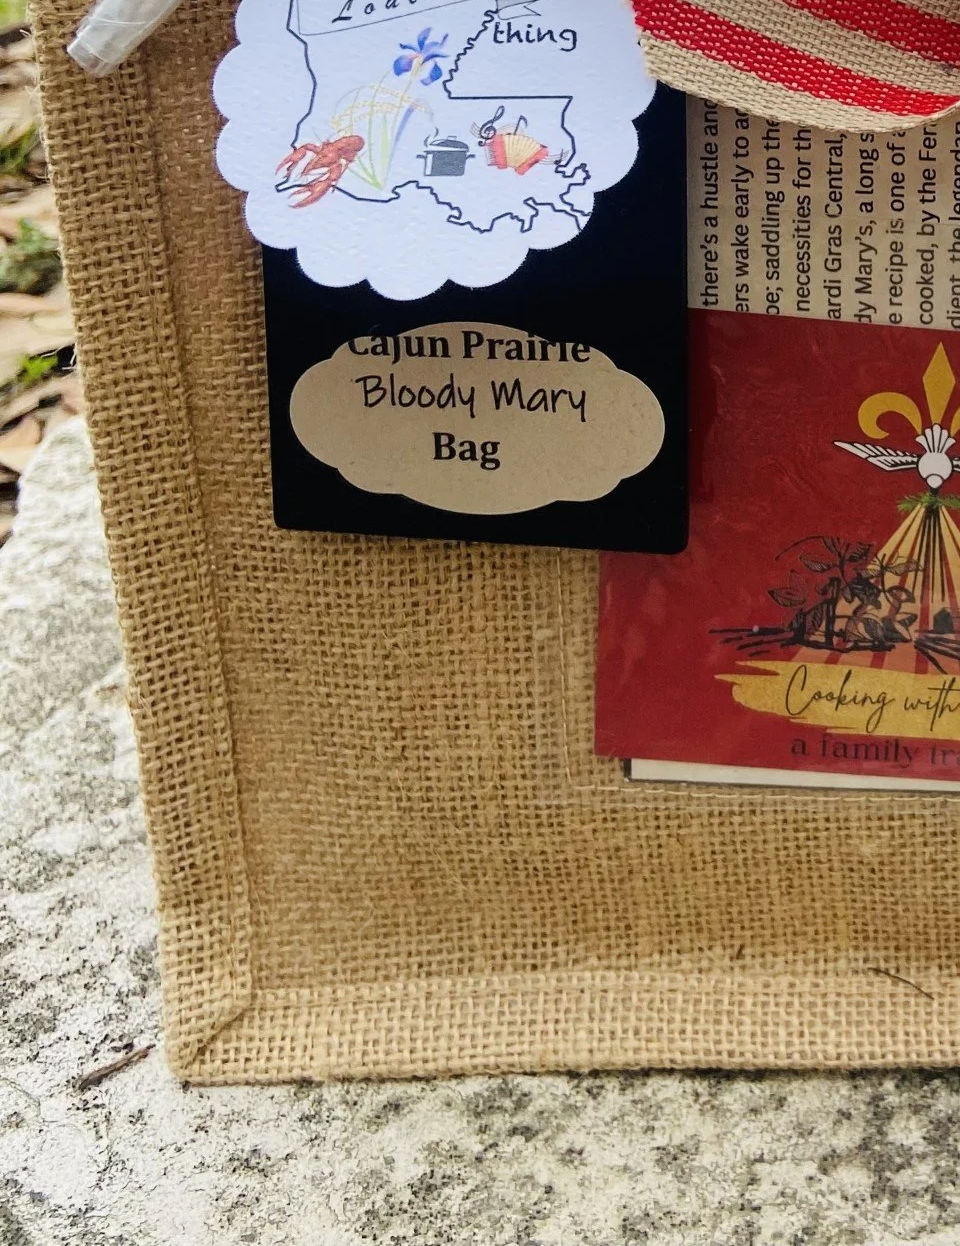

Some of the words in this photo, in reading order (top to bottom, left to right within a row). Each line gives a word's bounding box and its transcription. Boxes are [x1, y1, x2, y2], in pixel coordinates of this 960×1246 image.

[492, 21, 577, 52] thing
[733, 136, 750, 159] to
[793, 125, 812, 151] th
[887, 141, 906, 166] of
[919, 123, 938, 161] Fer
[700, 143, 719, 208] hustle
[766, 157, 785, 184] up
[793, 158, 812, 189] for
[824, 133, 847, 218] Central,
[855, 148, 880, 194] long
[918, 168, 937, 205] the
[731, 165, 754, 218] early
[860, 201, 874, 213] a
[891, 171, 906, 212] one
[704, 216, 719, 227] a
[761, 191, 785, 281] saddling
[886, 219, 904, 234] is
[916, 209, 940, 236] by
[731, 223, 750, 278] wake
[793, 195, 812, 312] necessities
[824, 224, 842, 273] Gras
[855, 219, 878, 294] Mary's,
[700, 233, 719, 306] there's
[885, 241, 908, 306] recipe
[916, 242, 939, 325] cooked,
[823, 280, 842, 320] ardi
[348, 335, 451, 365] Cajun
[461, 330, 591, 363] Prairie
[355, 373, 476, 418] Bloody
[491, 378, 587, 422] Mary
[433, 431, 501, 470] Bag
[785, 665, 896, 733] Cooking
[790, 738, 808, 755] a
[819, 733, 918, 768] family
